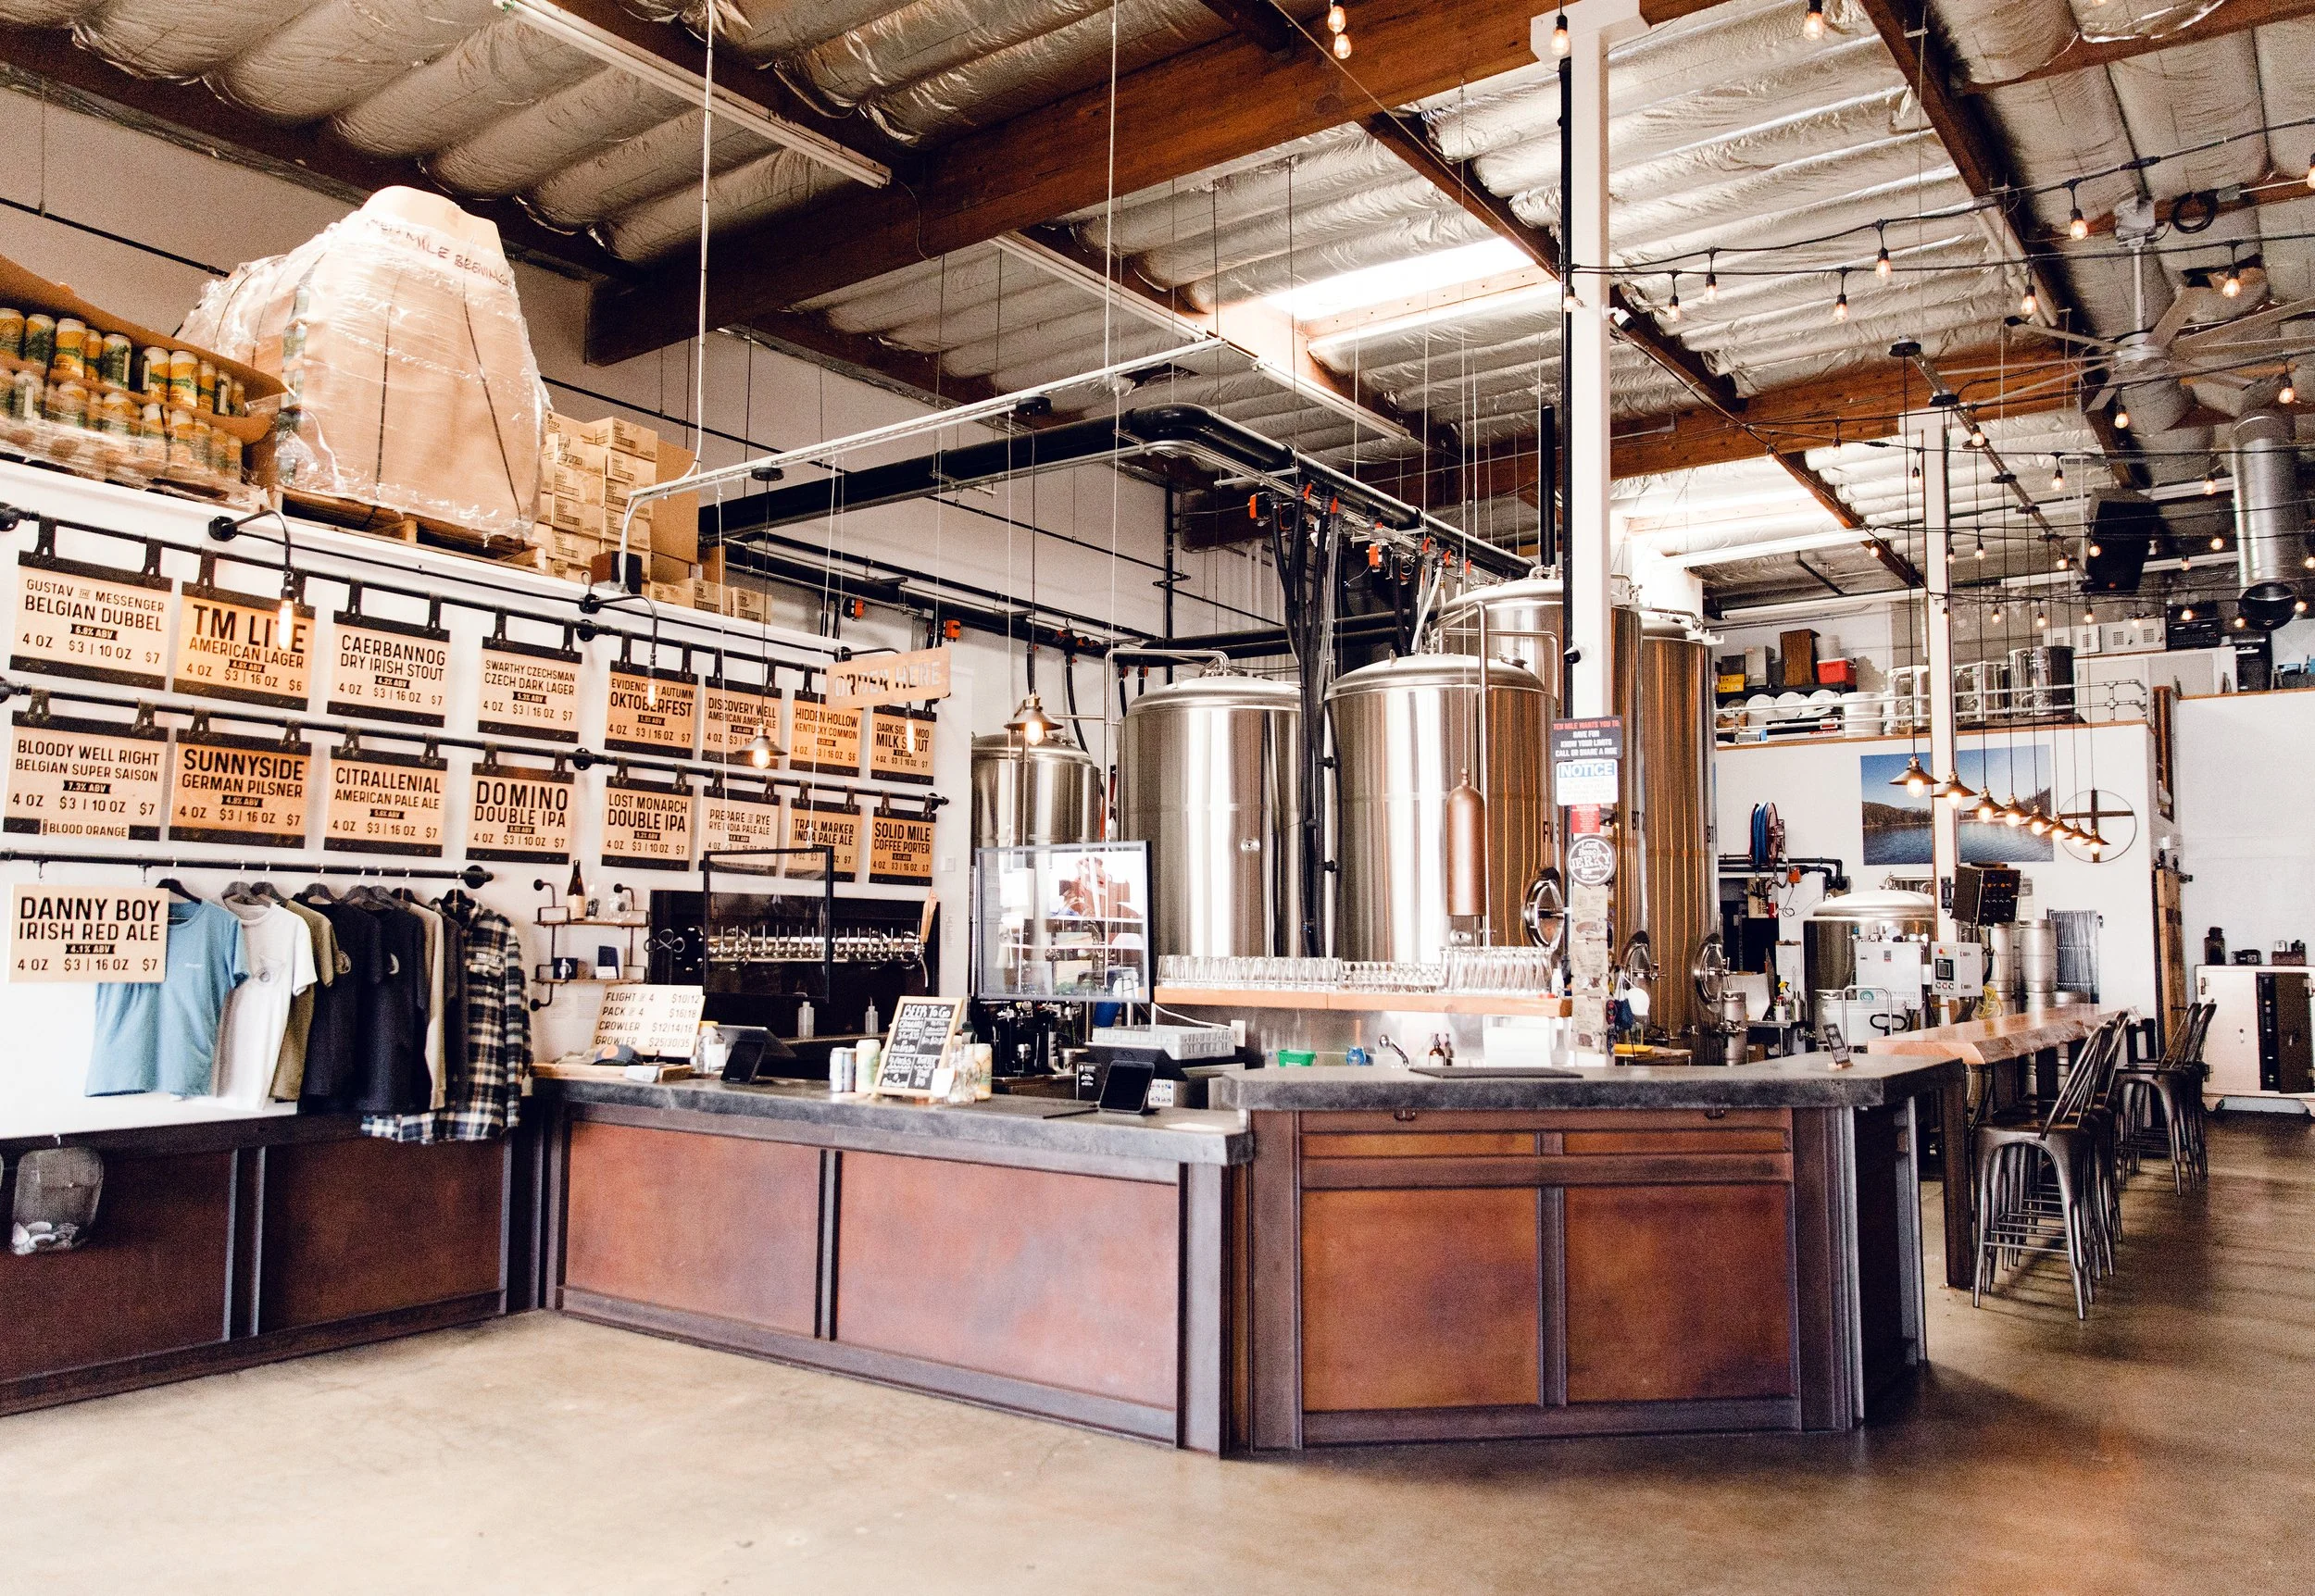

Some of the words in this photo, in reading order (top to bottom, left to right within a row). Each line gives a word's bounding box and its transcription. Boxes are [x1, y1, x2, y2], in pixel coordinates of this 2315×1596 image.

[26, 579, 74, 596] GUSTAV
[96, 592, 164, 612] MESSENGER
[25, 595, 95, 621] BELGIAN
[102, 608, 163, 631] DUBBEL
[95, 629, 113, 639] ABV
[194, 605, 237, 641] TM
[248, 615, 307, 655] LIE
[22, 633, 31, 644] 4
[36, 635, 53, 648] OZ
[69, 640, 84, 653] $3
[99, 644, 112, 656] 10
[116, 646, 131, 660] OZ
[145, 652, 160, 664] $7
[189, 637, 260, 661] AMERICAN
[265, 650, 304, 668] LAGER
[342, 635, 445, 667] CAERBANNOG
[248, 663, 263, 672] ABV
[341, 654, 366, 669] DRY
[369, 658, 403, 675] IRISH
[407, 664, 444, 681] STOUT
[485, 660, 525, 674] SWARTHY
[527, 667, 575, 681] CZECHSMAN
[394, 680, 407, 688] ABV
[485, 673, 516, 687] CZECH
[519, 678, 544, 691] DARK
[546, 681, 574, 695] LAGER
[835, 668, 890, 697] ORDER
[895, 661, 941, 689] HERE
[612, 679, 648, 692] EVIDENC
[661, 687, 694, 699] AUTUMN
[756, 705, 776, 717] WELL
[795, 707, 826, 723] HIDDEN
[828, 713, 858, 728] HOLLOW
[766, 719, 776, 729] ALE
[877, 723, 894, 733] DARK
[895, 725, 907, 735] SID
[916, 728, 929, 738] MOO
[829, 728, 857, 740] COMMON
[876, 733, 898, 748] MILK
[902, 737, 929, 752] SOUT
[18, 739, 75, 757] BLOODY
[79, 745, 115, 762] WELL
[119, 750, 160, 766] RIGHT
[1580, 748, 1598, 756] SHARE
[16, 758, 69, 774] BELGIAN
[72, 764, 111, 778] SUPER
[115, 768, 158, 781] SAISON
[184, 748, 305, 780] SUNNYSIDE
[1561, 763, 1614, 777] NOTICE
[69, 781, 87, 792] 7.3%
[89, 783, 106, 793] ABV
[181, 774, 244, 792] GERMAN
[247, 779, 303, 798] PILSNER
[336, 767, 441, 793] CITRALLENIAL
[12, 793, 20, 804] 4
[26, 794, 44, 807] OZ
[59, 796, 76, 810] $3
[93, 800, 106, 812] 10
[109, 801, 126, 813] OZ
[140, 802, 156, 816] $7
[244, 797, 259, 806] ABV
[334, 789, 392, 805] AMERICAN
[394, 794, 419, 807] PALE
[421, 797, 440, 809] ALE
[477, 780, 568, 811] DOMINO
[608, 793, 633, 807] LOST
[637, 796, 687, 813] MONARCH
[474, 805, 536, 825] DOUBLE
[543, 811, 566, 828] IPA
[607, 809, 661, 829] DOUBLE
[665, 814, 685, 832] IPA
[756, 815, 770, 826] RYE
[49, 823, 83, 834] BLOOD
[85, 825, 127, 837] ORANGE
[709, 821, 721, 829] RYE
[743, 824, 757, 834] PALE
[759, 827, 770, 836] ALE
[795, 819, 818, 830] TRAIL
[820, 821, 854, 834] MARKER
[875, 822, 905, 839] SOLID
[907, 826, 931, 842] MILE
[819, 832, 837, 843] PALE
[839, 834, 853, 845] ALE
[874, 839, 901, 852] COFFEE
[903, 842, 930, 854] PORTER
[1570, 854, 1610, 868] JERKY
[20, 896, 108, 921] DANNY
[116, 899, 160, 922] BOY
[19, 922, 74, 940] IRISH
[82, 923, 119, 941] RED
[126, 924, 160, 941] ALE
[69, 944, 91, 954] 4.1%
[93, 944, 110, 954] ABV
[18, 958, 25, 970] 4
[31, 958, 48, 970] OZ
[64, 958, 81, 971] $3
[96, 959, 108, 970] 16
[113, 959, 129, 970] OZ
[143, 958, 157, 971] $7
[606, 992, 637, 1002] FLIGHT
[649, 993, 654, 1002] 4
[602, 1007, 626, 1016] PACK
[639, 1008, 644, 1016] 4
[903, 1005, 927, 1017] BEER
[598, 1020, 641, 1030] CROWLER
[595, 1035, 637, 1045] GROWLER
